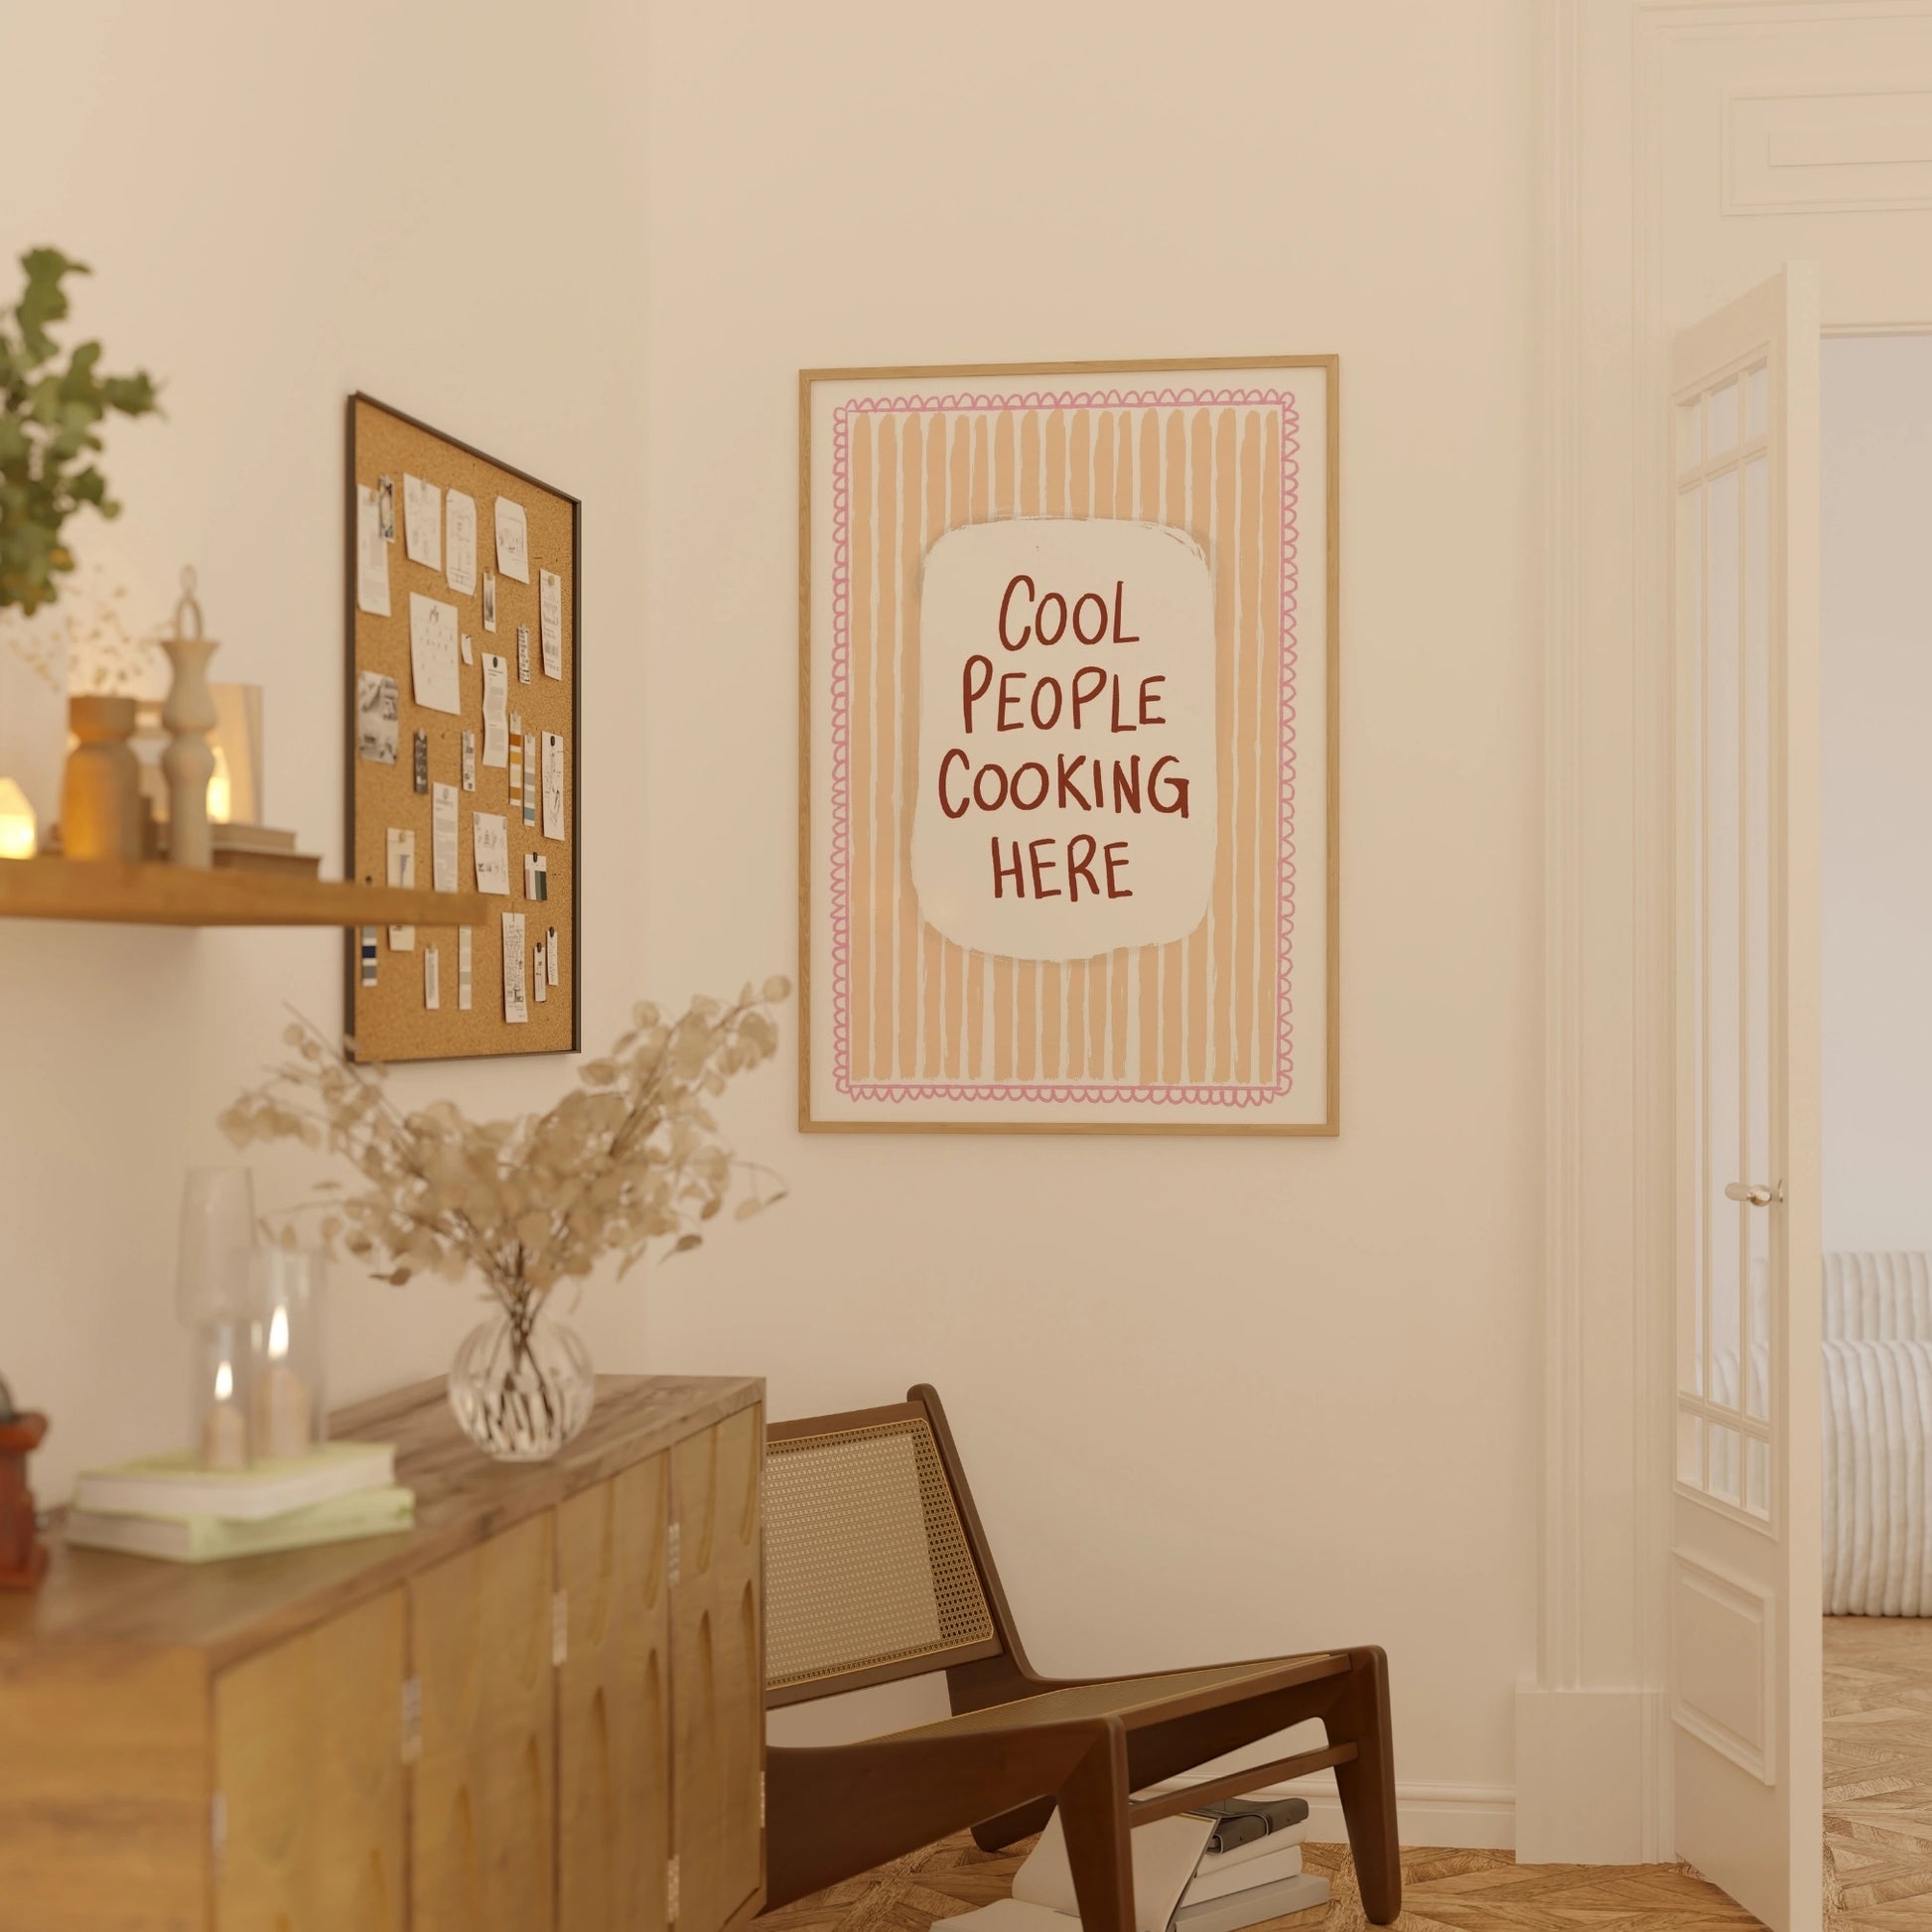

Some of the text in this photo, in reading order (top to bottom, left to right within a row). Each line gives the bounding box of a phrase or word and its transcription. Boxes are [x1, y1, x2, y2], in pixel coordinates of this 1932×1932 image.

[999, 575, 1140, 652] COOL
[962, 654, 1166, 734] PEOPLE
[938, 748, 1189, 818] COOKING
[991, 834, 1133, 902] HERE
